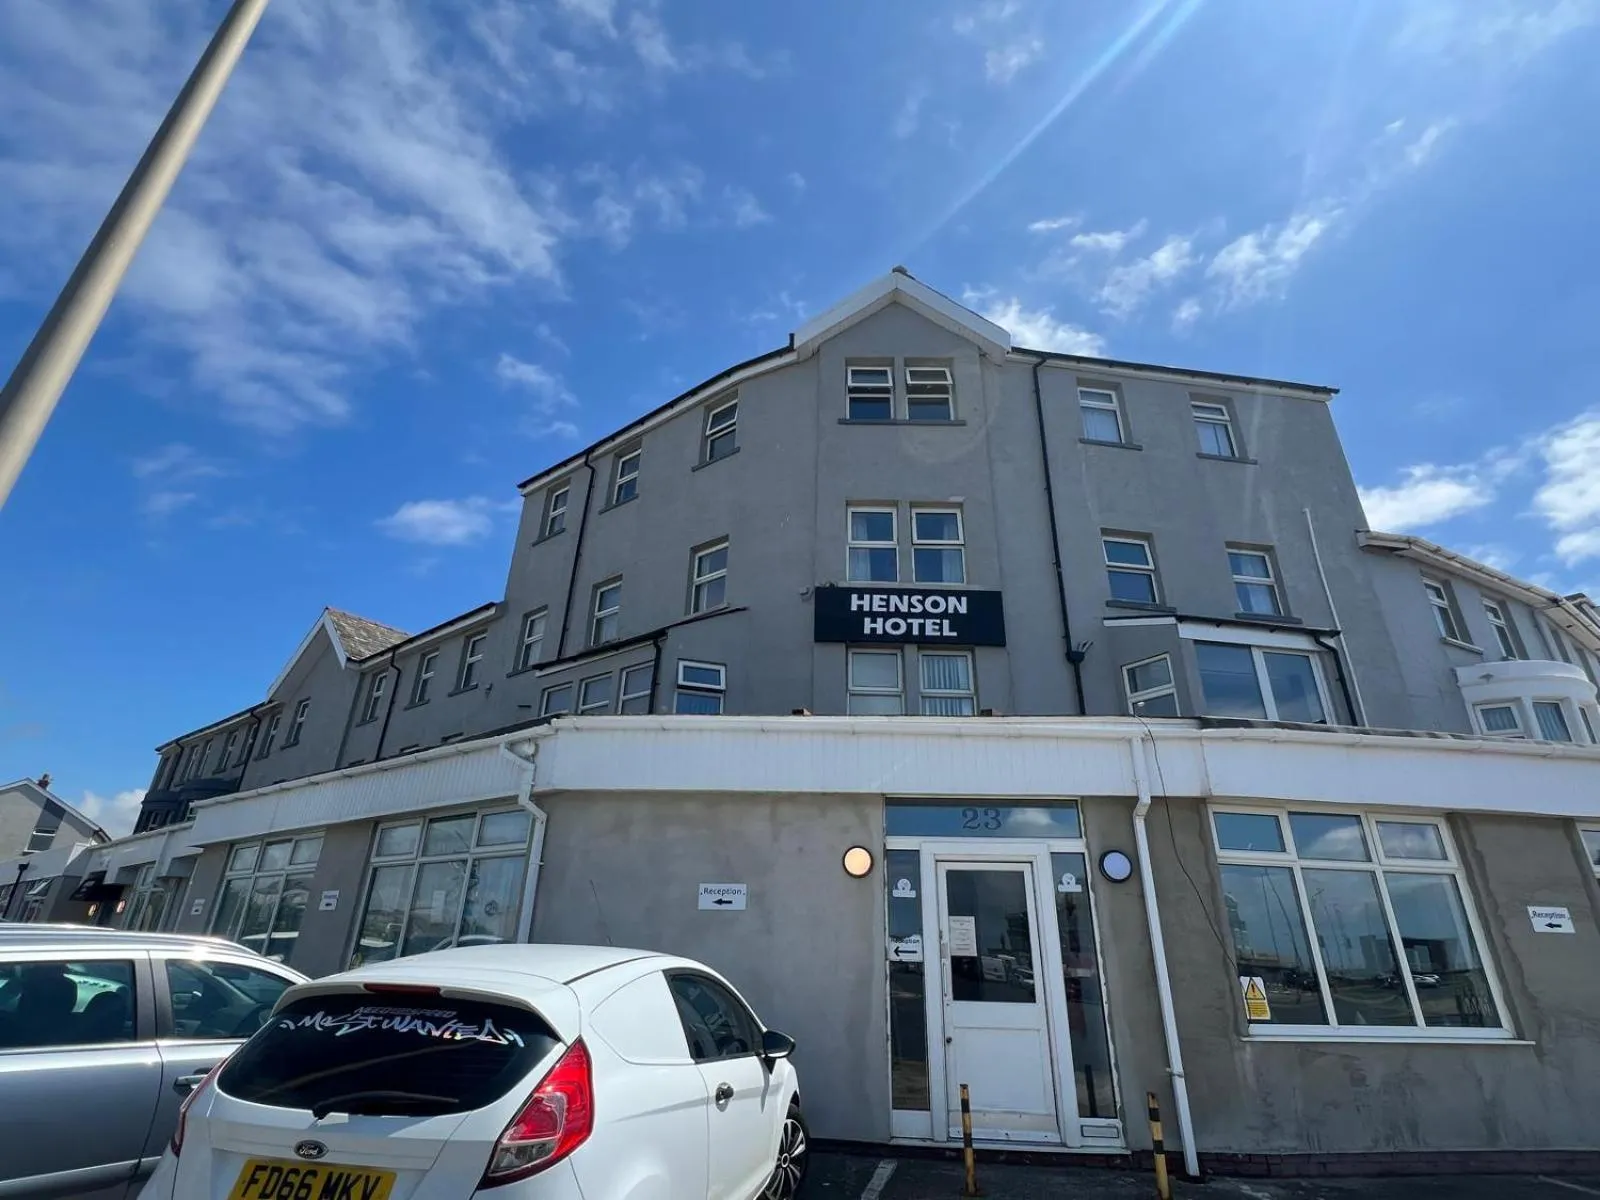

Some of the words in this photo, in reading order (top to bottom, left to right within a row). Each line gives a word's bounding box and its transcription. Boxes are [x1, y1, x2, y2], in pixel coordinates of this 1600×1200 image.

[850, 593, 968, 614] HENSON
[863, 617, 957, 637] HOTEL
[961, 807, 1002, 830] 23
[241, 1165, 318, 1200] FD66
